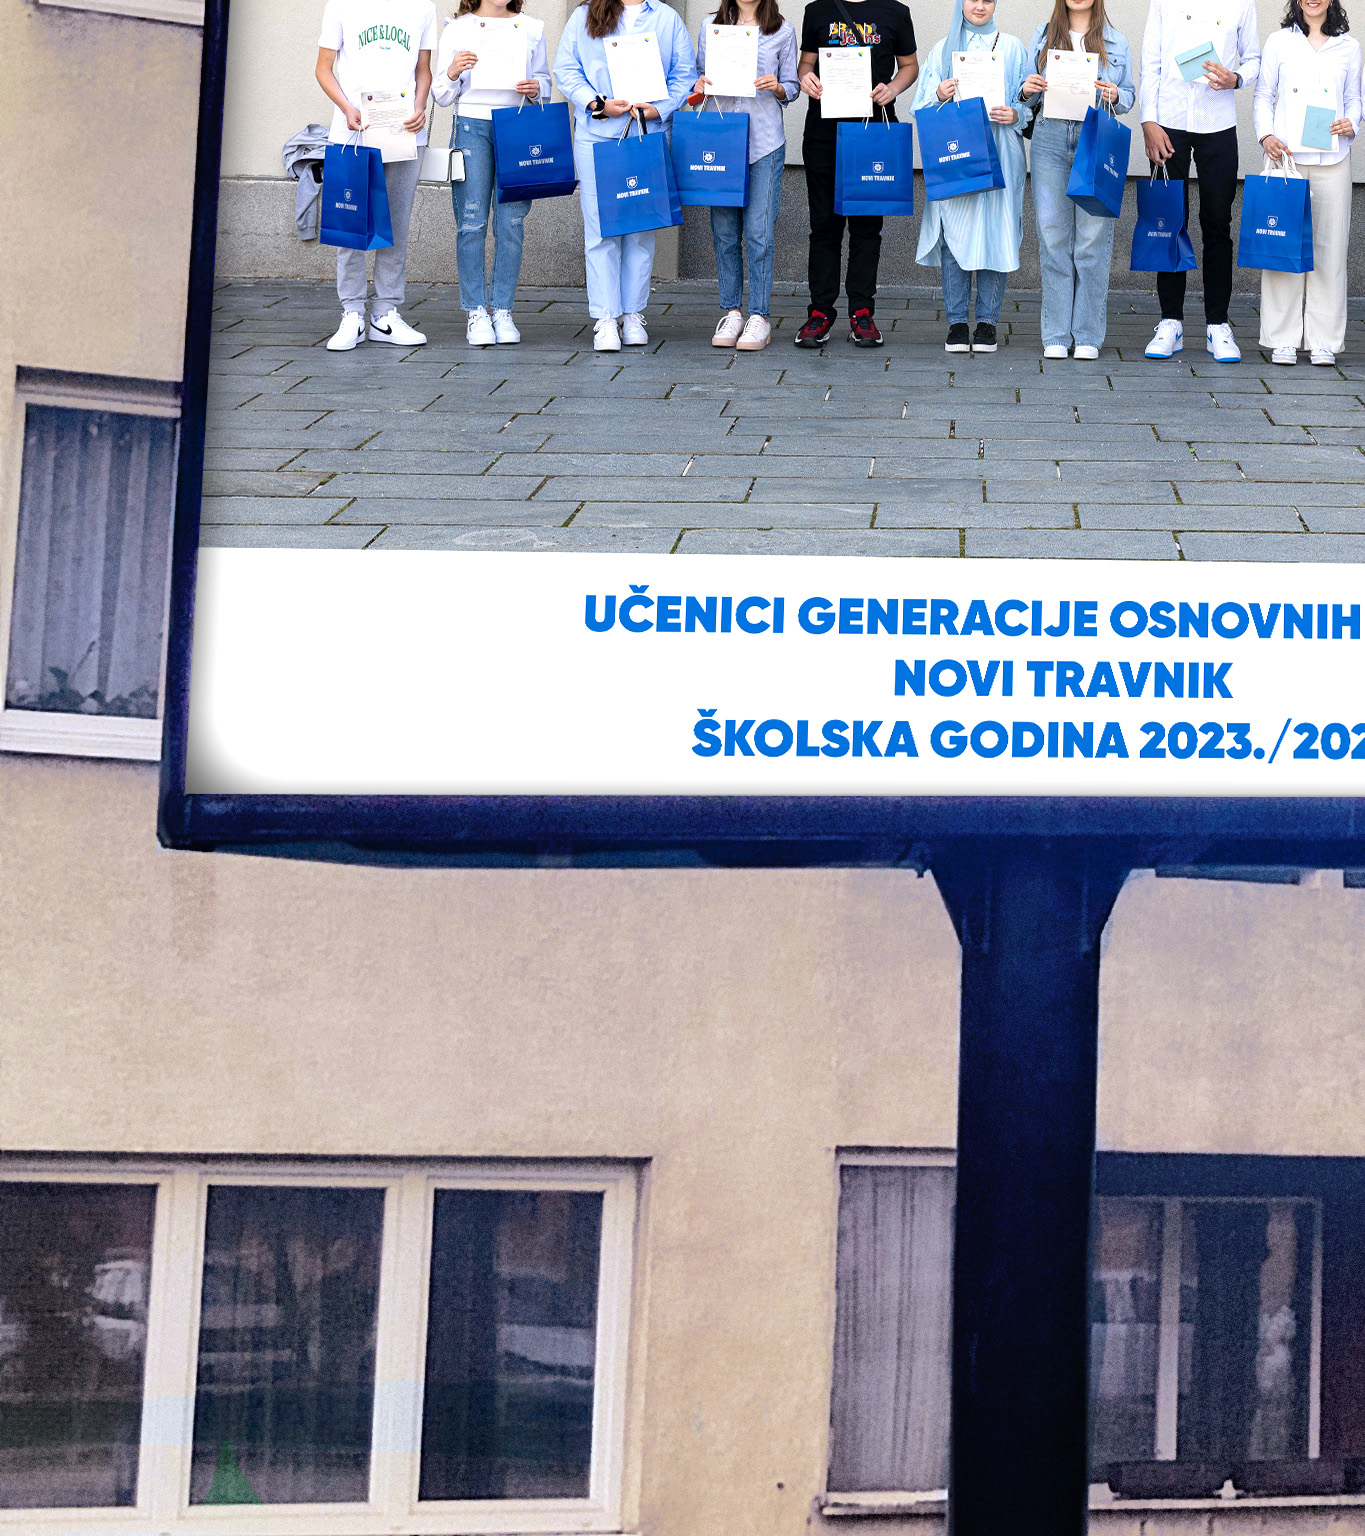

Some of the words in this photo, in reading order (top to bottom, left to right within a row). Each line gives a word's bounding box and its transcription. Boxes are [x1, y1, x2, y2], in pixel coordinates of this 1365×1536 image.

[358, 25, 378, 50] NICE
[385, 25, 411, 52] LOCAL
[840, 30, 881, 46] Jens
[519, 159, 532, 167] NOVI
[585, 585, 784, 634] UČENICI
[798, 597, 1098, 637] GENERACIJE
[1110, 601, 1360, 640] OSNOVNIH
[895, 659, 1013, 697] NOVI
[1027, 661, 1233, 698] TRAVNIK
[692, 709, 919, 757] ŠKOLSKA
[930, 720, 1129, 758] GODINA
